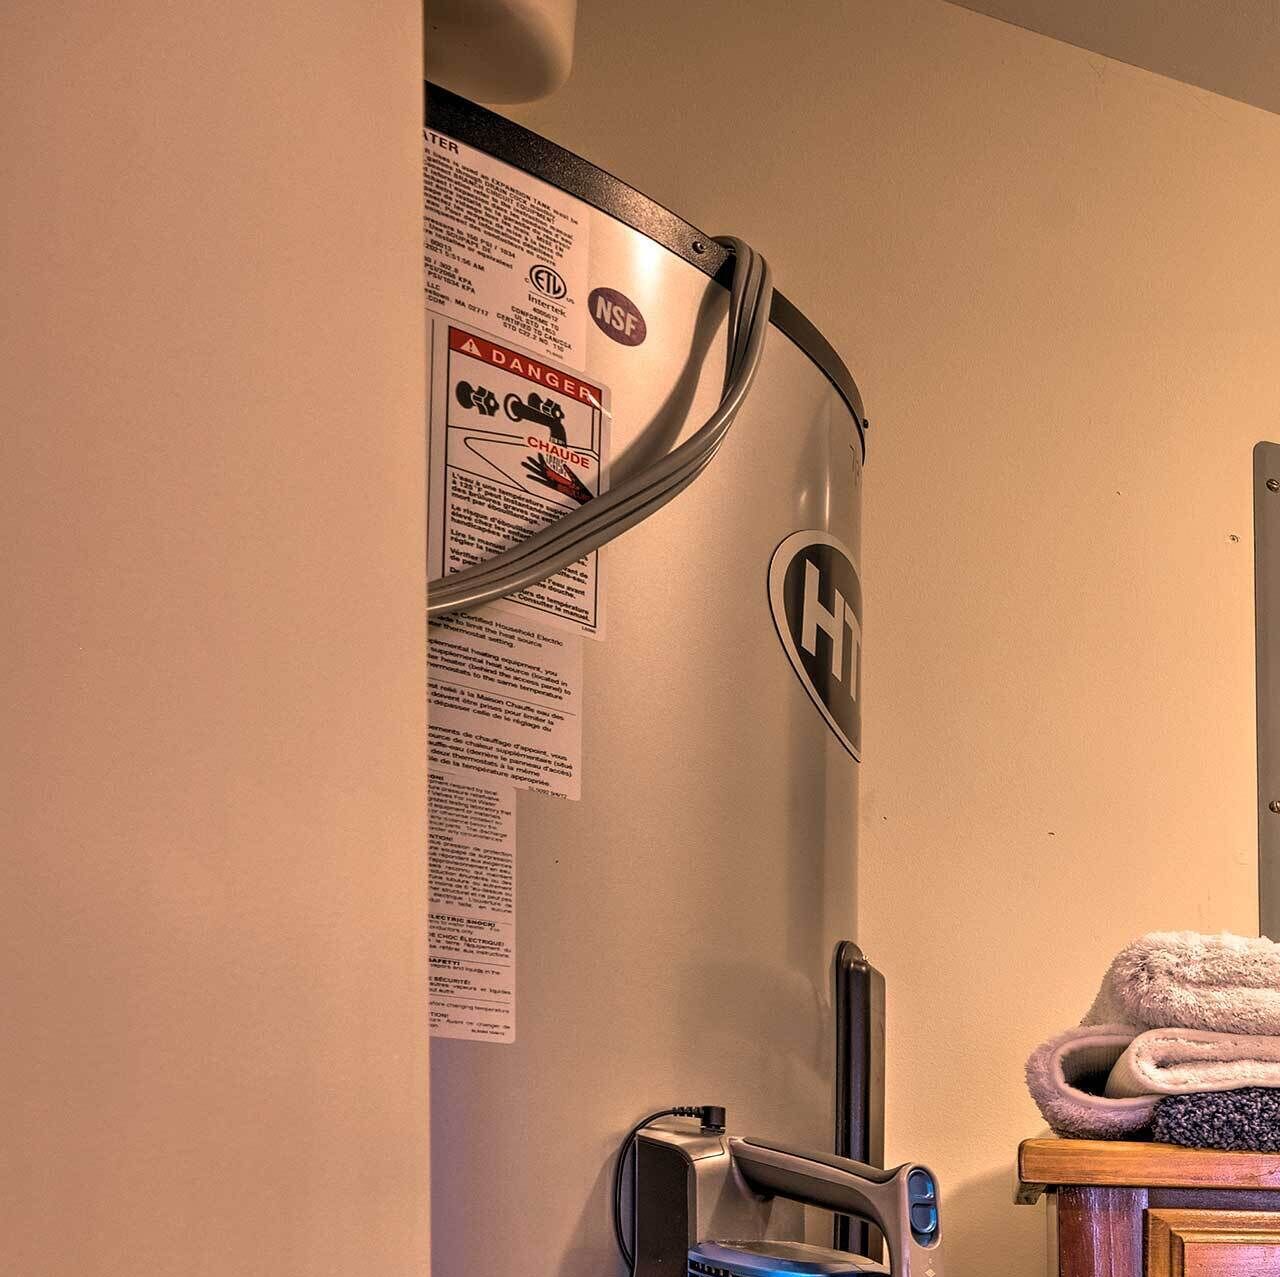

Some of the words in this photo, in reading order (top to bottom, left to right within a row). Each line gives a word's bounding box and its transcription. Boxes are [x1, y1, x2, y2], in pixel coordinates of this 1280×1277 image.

[453, 172, 484, 191] BRANCH
[486, 187, 514, 204] CIRCUIT
[516, 202, 555, 225] EQUIPMENT
[485, 181, 507, 195] DRAIN
[510, 191, 527, 206] COCK
[491, 178, 531, 201] EXPANSION
[500, 248, 515, 259] 1034
[455, 298, 465, 307] MA
[468, 303, 489, 317] 02717
[511, 305, 548, 327] CONFORMS
[550, 322, 559, 331] TO
[596, 297, 638, 338] NSF
[497, 311, 531, 331] CERTIFIED
[533, 327, 543, 337] TO
[503, 321, 516, 332] STD
[492, 350, 591, 400] DANGER
[527, 435, 590, 469] CHAUDE
[451, 492, 470, 502] mort
[459, 480, 473, 490] 125
[484, 490, 501, 501] peut
[482, 483, 496, 492] une
[451, 485, 467, 495] des
[503, 502, 528, 515] graves
[451, 503, 461, 512] Le
[463, 508, 487, 522] risque
[451, 529, 466, 539] Lire
[518, 593, 554, 609] Consulter
[566, 586, 585, 596] avant
[443, 623, 486, 640] thermostat
[461, 612, 493, 626] Certified
[495, 622, 535, 639] Household
[537, 633, 563, 648] Electric
[466, 621, 482, 631] limit
[499, 631, 515, 641] heat
[517, 637, 542, 648] source
[431, 647, 483, 664] supplemental
[485, 660, 502, 669] heat
[504, 665, 529, 677] source
[440, 657, 465, 668] heater
[468, 663, 497, 677] (behind
[499, 670, 511, 679] the
[513, 676, 539, 688] access
[470, 648, 499, 662] heating
[545, 669, 557, 678] you
[477, 692, 504, 706] Maison
[496, 680, 518, 689] same
[520, 684, 563, 701] temperature
[479, 702, 502, 714] prises
[504, 708, 522, 719] pour
[440, 757, 451, 766] de
[461, 762, 509, 778] température
[452, 752, 498, 769] thermostats
[509, 758, 541, 771] panneau
